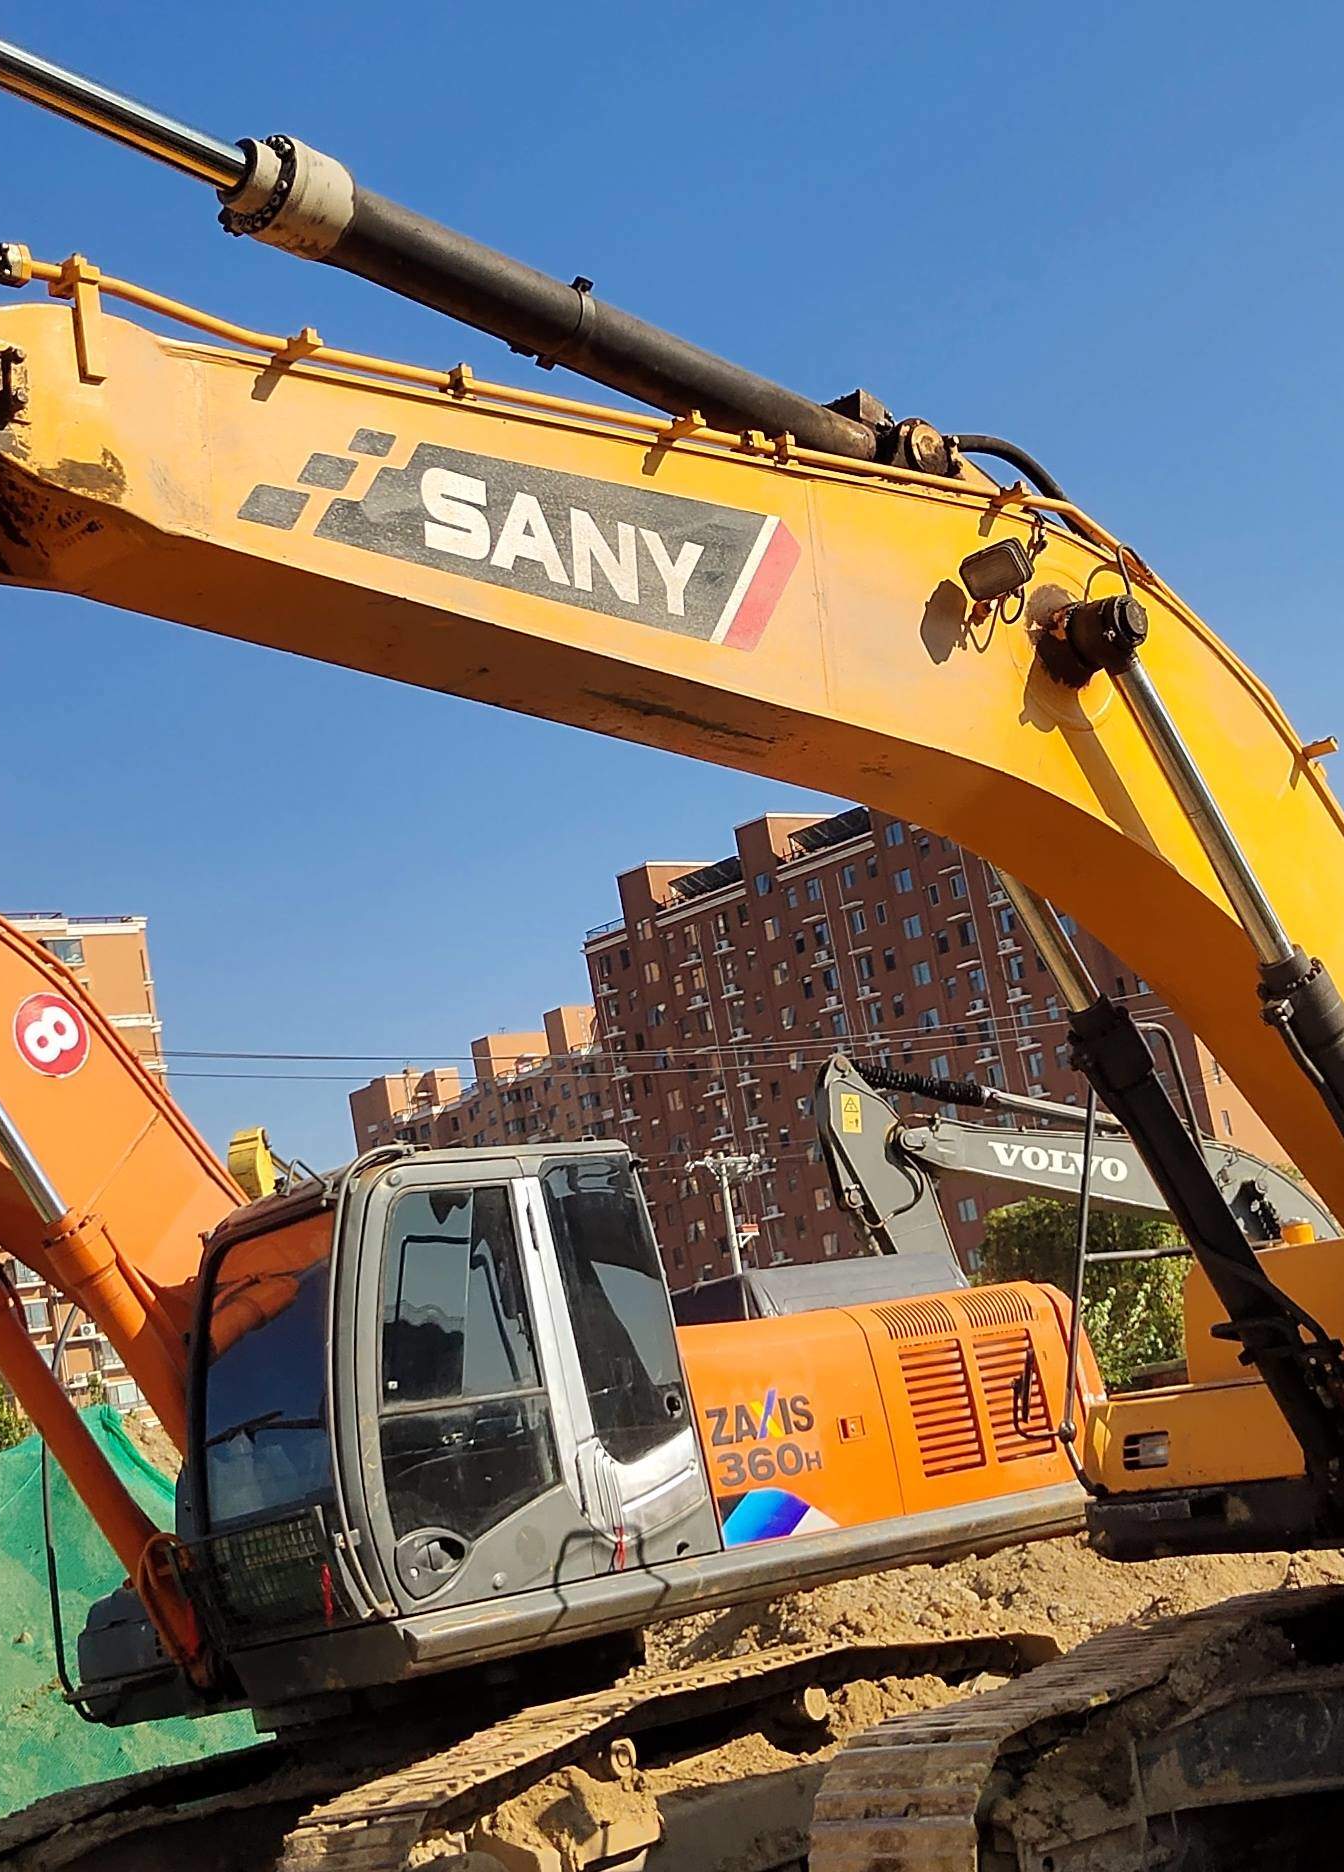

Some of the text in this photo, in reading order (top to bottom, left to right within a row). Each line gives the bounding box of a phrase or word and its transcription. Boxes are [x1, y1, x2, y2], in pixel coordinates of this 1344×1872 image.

[420, 467, 704, 616] SANY
[24, 1006, 79, 1063] 8
[988, 1141, 1128, 1182] VOLVO
[705, 1389, 815, 1447] ZAXIS
[716, 1442, 823, 1487] 360H
